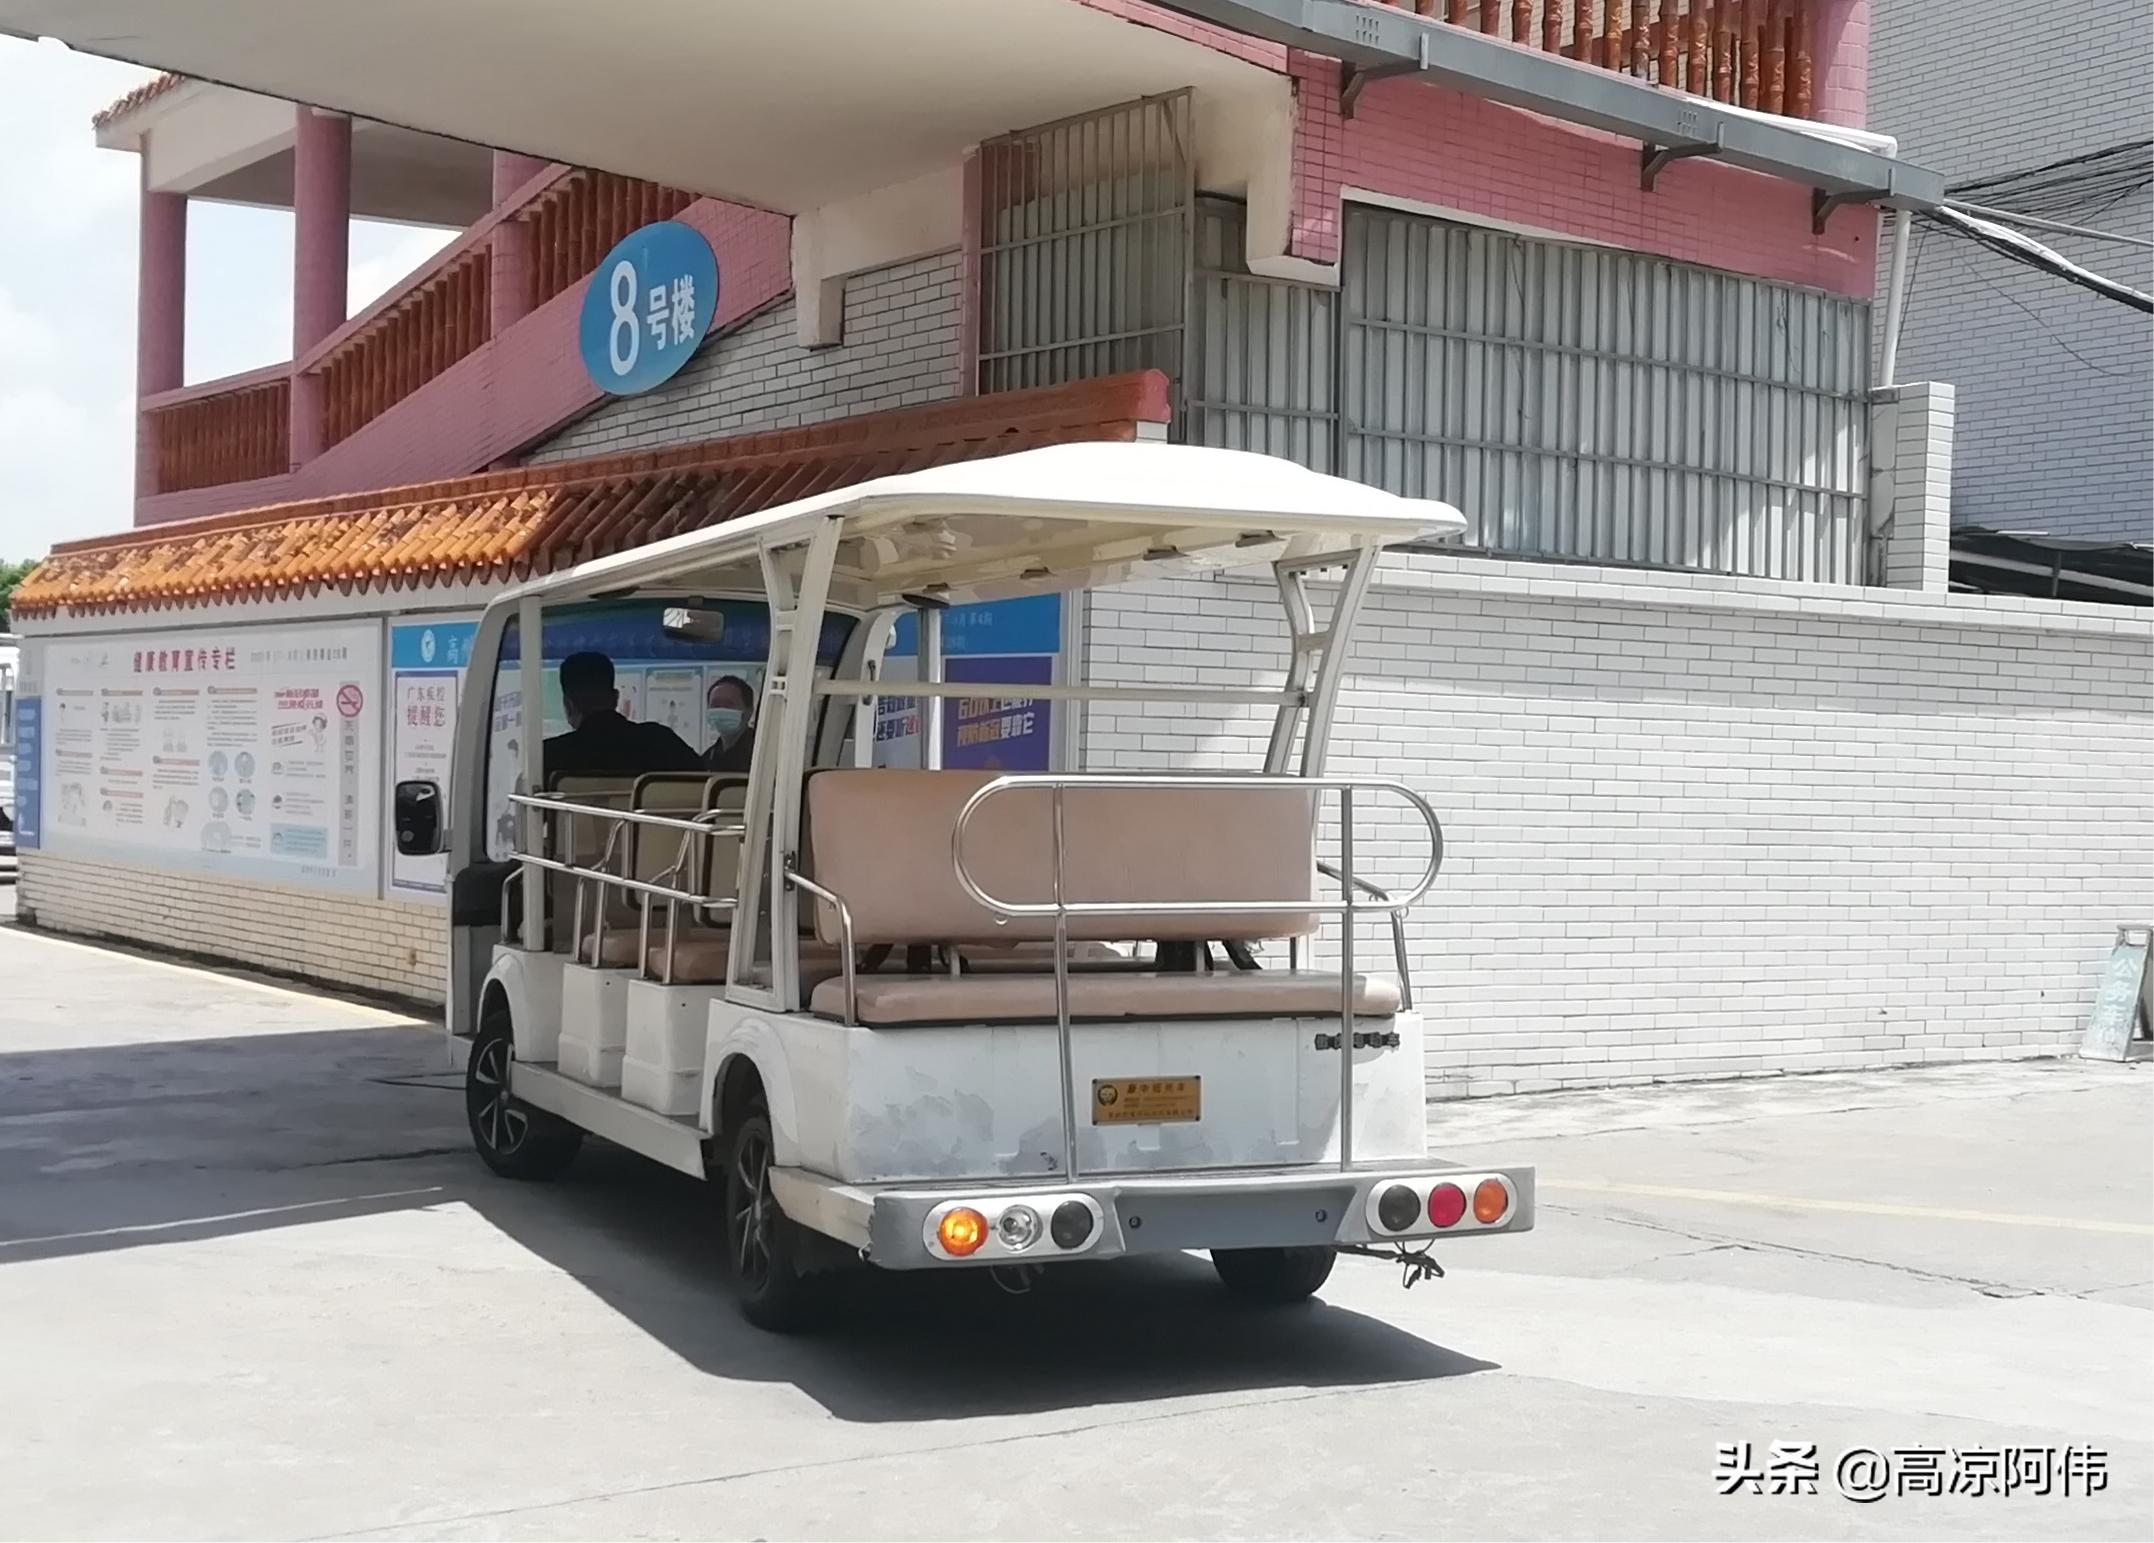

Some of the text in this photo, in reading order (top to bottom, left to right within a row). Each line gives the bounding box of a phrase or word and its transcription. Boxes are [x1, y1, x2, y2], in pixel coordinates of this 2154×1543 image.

[610, 260, 695, 375] 8号楼
[134, 647, 235, 672] 健康教育宣传专栏
[407, 686, 445, 701] 广东疾控
[407, 705, 446, 727] 提醒您
